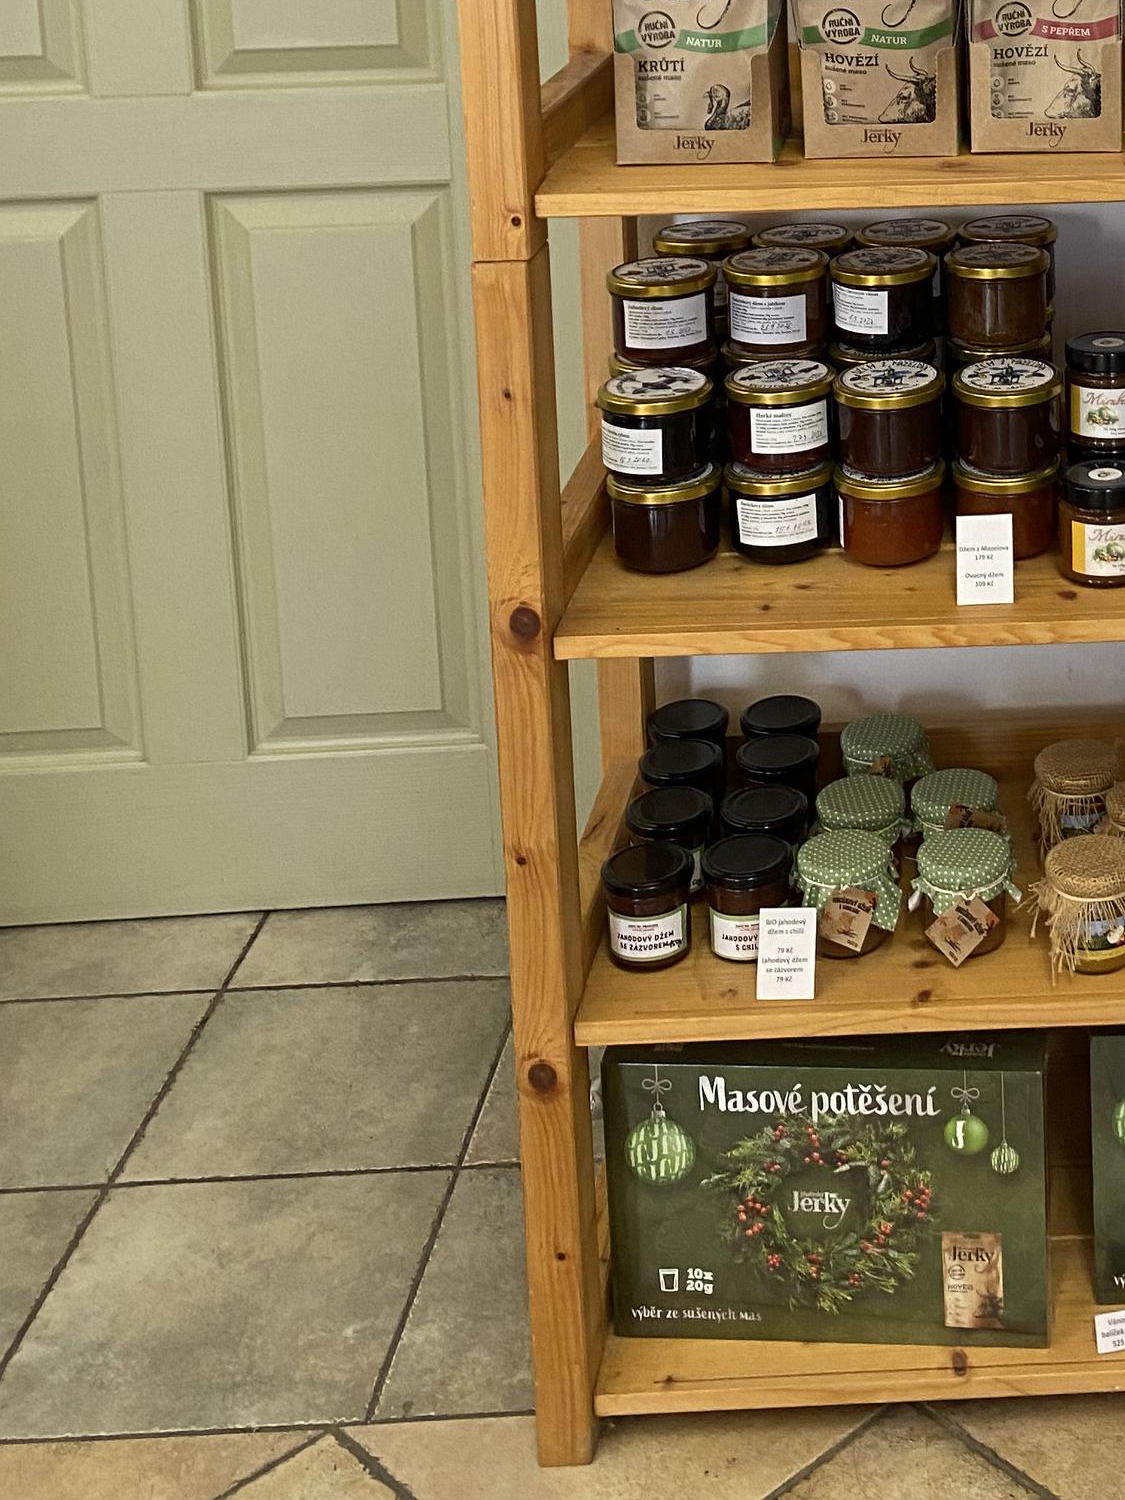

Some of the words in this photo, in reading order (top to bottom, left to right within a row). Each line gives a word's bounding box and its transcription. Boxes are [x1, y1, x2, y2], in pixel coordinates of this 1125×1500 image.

[1041, 24, 1048, 33] S
[1049, 25, 1091, 37] PEPŘEM
[686, 36, 722, 48] NATUR
[871, 34, 907, 45] NATUR
[993, 44, 1049, 59] HOVĚZÍ
[638, 55, 685, 73] KRŮTÍ
[824, 52, 880, 67] HOVĚZÍ
[861, 128, 902, 154] Jerky
[1026, 121, 1067, 148] Jerky
[673, 135, 715, 160] Jerky
[698, 1075, 804, 1114] Masové
[811, 1083, 942, 1119] potěšení
[787, 1190, 851, 1230] Jerky
[687, 1268, 714, 1280] 10x
[686, 1280, 714, 1294] 20g
[666, 1309, 678, 1319] ze
[682, 1306, 736, 1323] sušených
[1101, 1327, 1124, 1338] balíček
